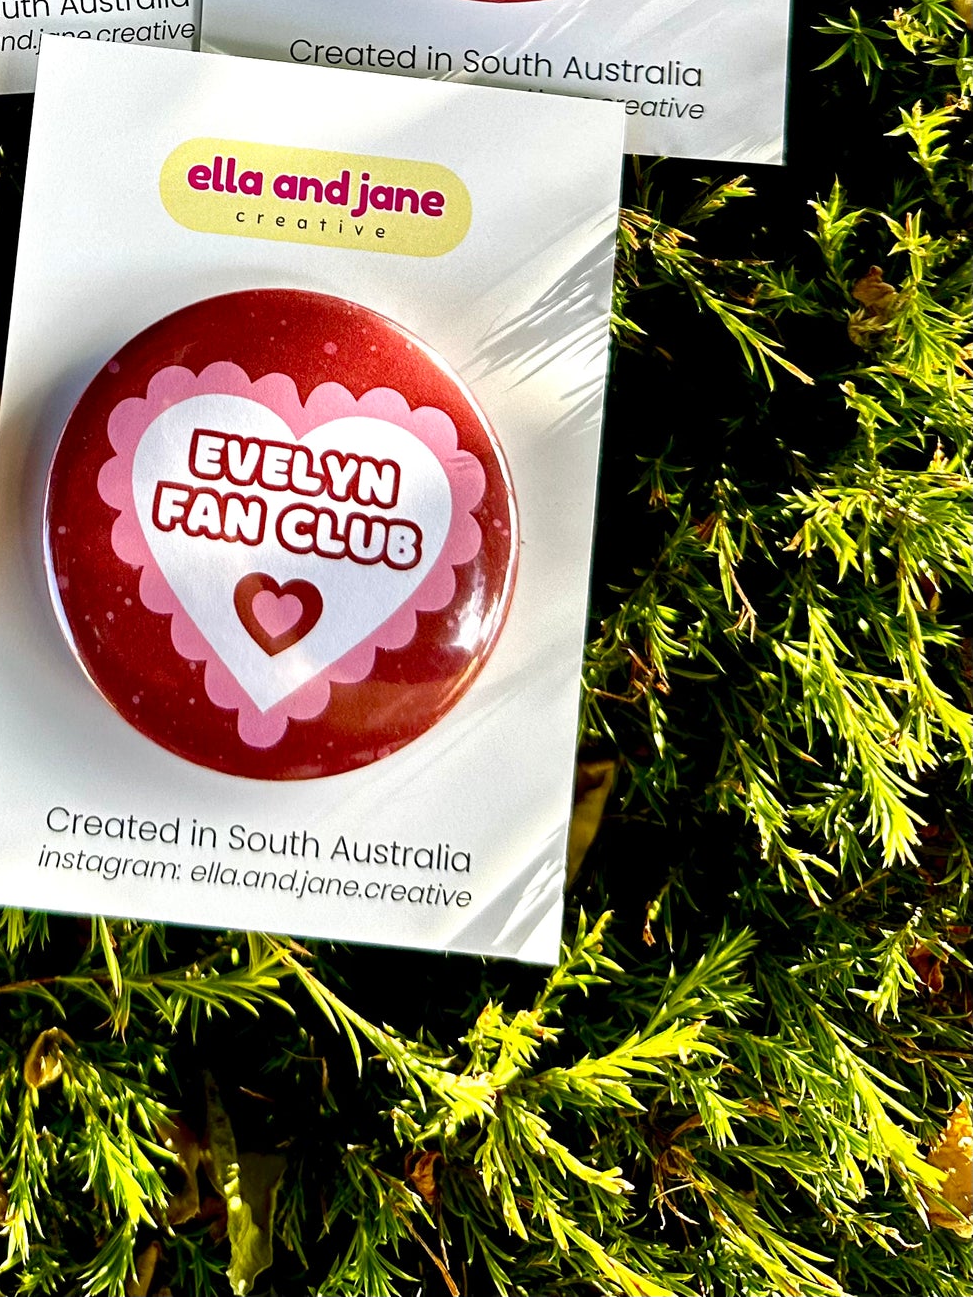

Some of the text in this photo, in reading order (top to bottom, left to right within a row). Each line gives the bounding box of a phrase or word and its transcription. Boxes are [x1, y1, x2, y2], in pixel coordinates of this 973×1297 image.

[288, 38, 703, 88] Created in South Australia
[186, 155, 446, 218] ella and jane
[234, 208, 388, 240] creative
[188, 428, 402, 510] EVELYN
[152, 481, 424, 571] FAN CLUB
[45, 805, 472, 875] Created in South Australia
[37, 843, 473, 909] instagram: ella.and.jane.creative
